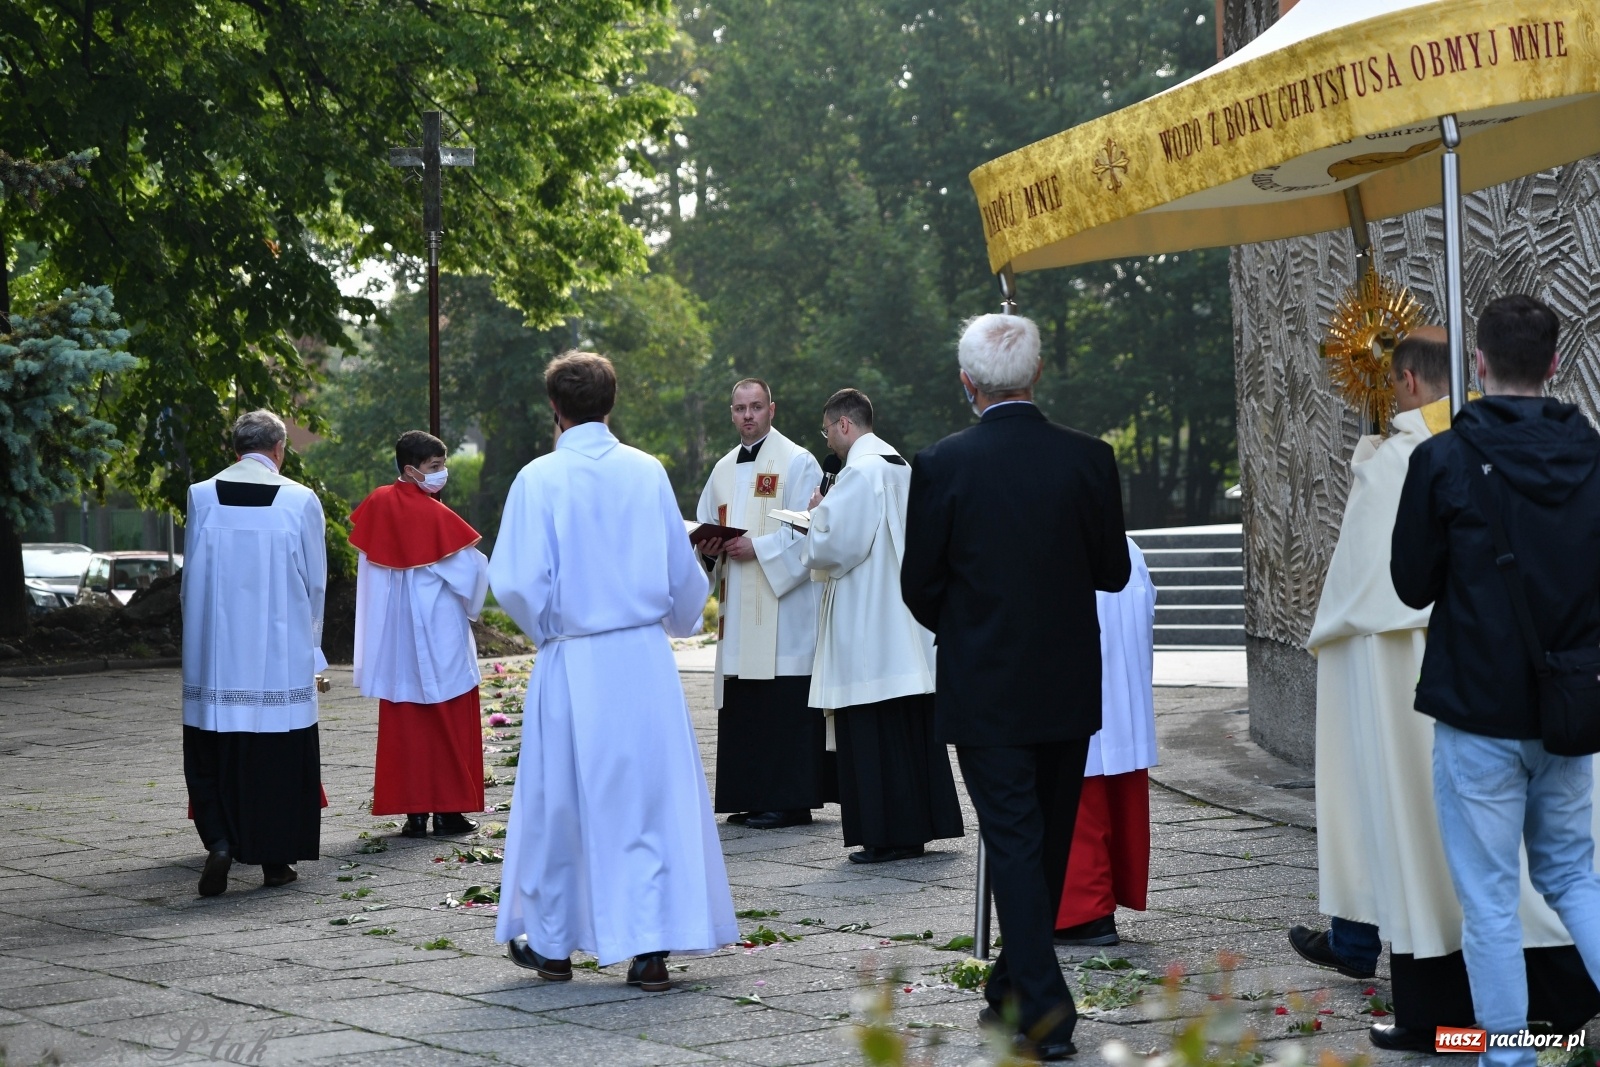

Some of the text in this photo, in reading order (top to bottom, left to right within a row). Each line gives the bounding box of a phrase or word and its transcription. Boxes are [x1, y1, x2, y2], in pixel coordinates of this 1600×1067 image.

[1159, 20, 1568, 164] WODO Z BOKU CHRYSTUSA OBMYJ MNIE
[1023, 173, 1063, 219] MNIE
